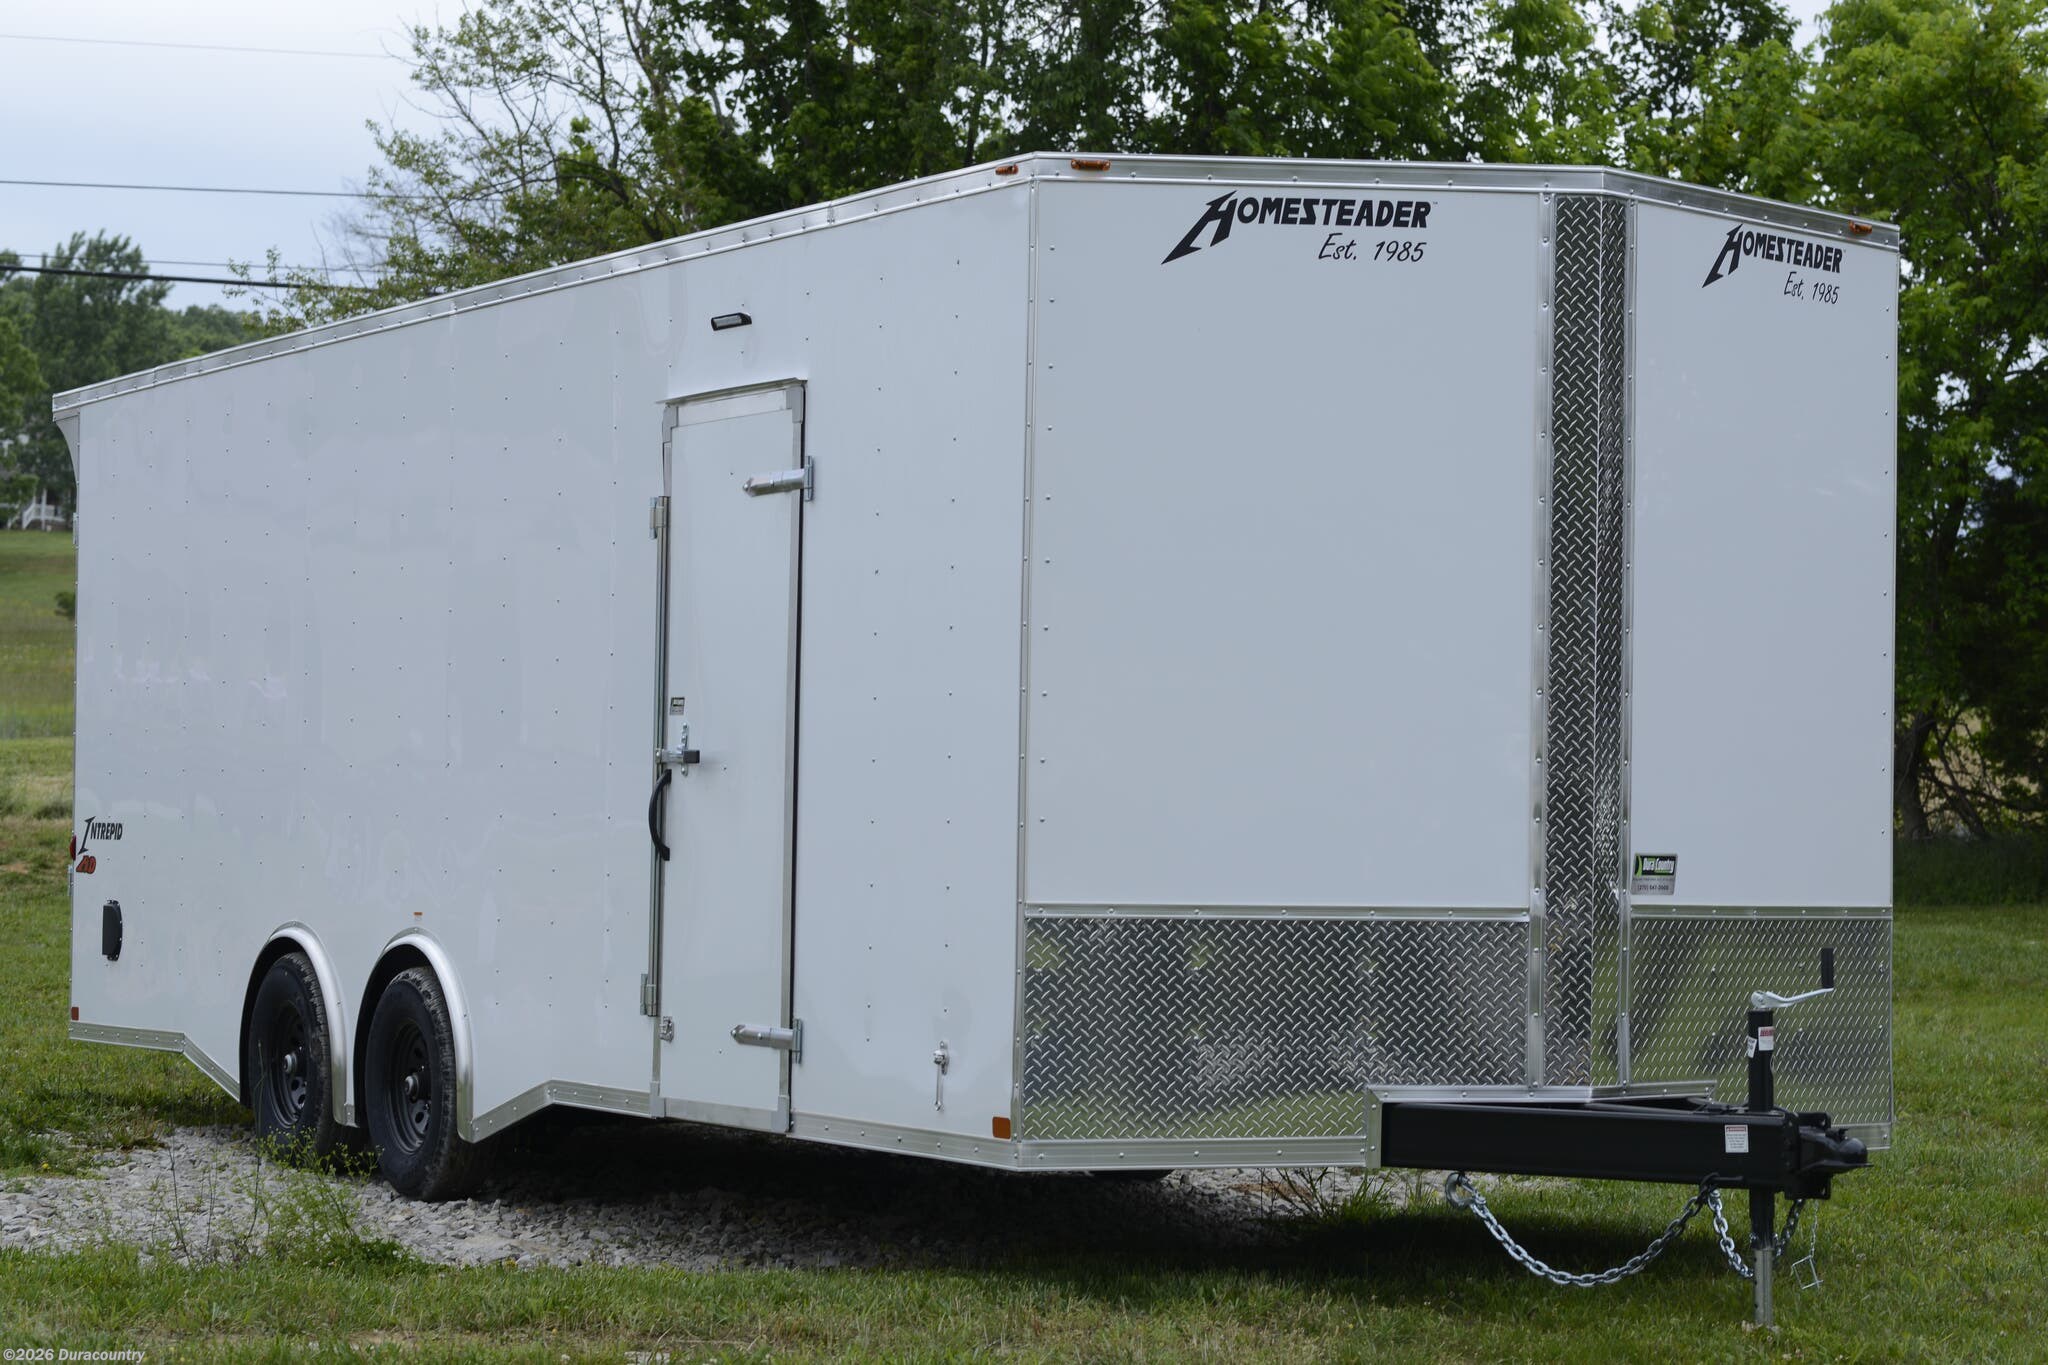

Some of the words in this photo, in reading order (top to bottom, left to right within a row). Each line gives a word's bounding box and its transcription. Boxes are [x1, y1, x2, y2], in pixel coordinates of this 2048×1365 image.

[1161, 190, 1431, 264] HOMESTEADER
[1318, 233, 1357, 260] Est.
[1373, 241, 1427, 262] 1985
[1702, 223, 1843, 288] HOMESTEADER
[1784, 271, 1804, 300] Est.
[1812, 282, 1840, 304] 1985
[77, 816, 123, 855] INTREPID
